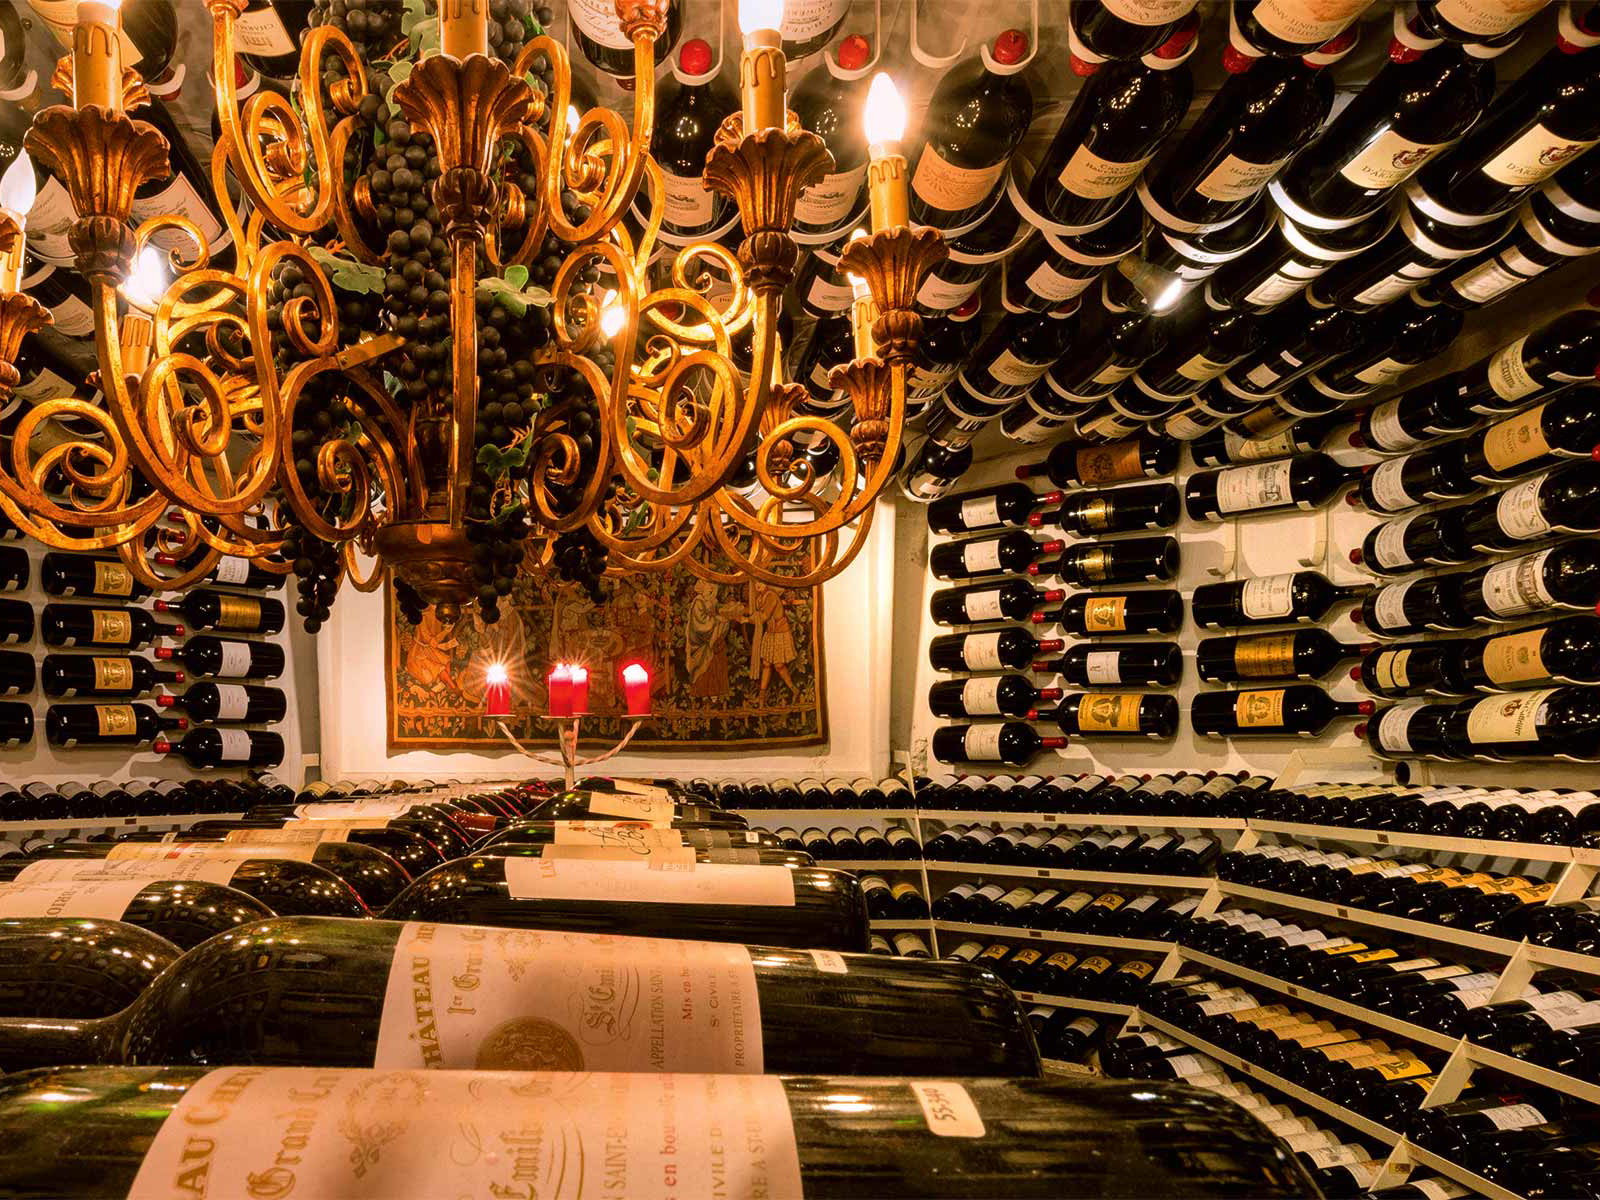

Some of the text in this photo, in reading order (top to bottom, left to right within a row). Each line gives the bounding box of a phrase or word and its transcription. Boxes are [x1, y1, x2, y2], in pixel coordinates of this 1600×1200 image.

[409, 956, 443, 1069] HÂTEAU
[647, 994, 666, 1070] APPELLATION
[176, 1136, 215, 1200] AU
[662, 1164, 677, 1188] en
[710, 1143, 727, 1199] IVILE
